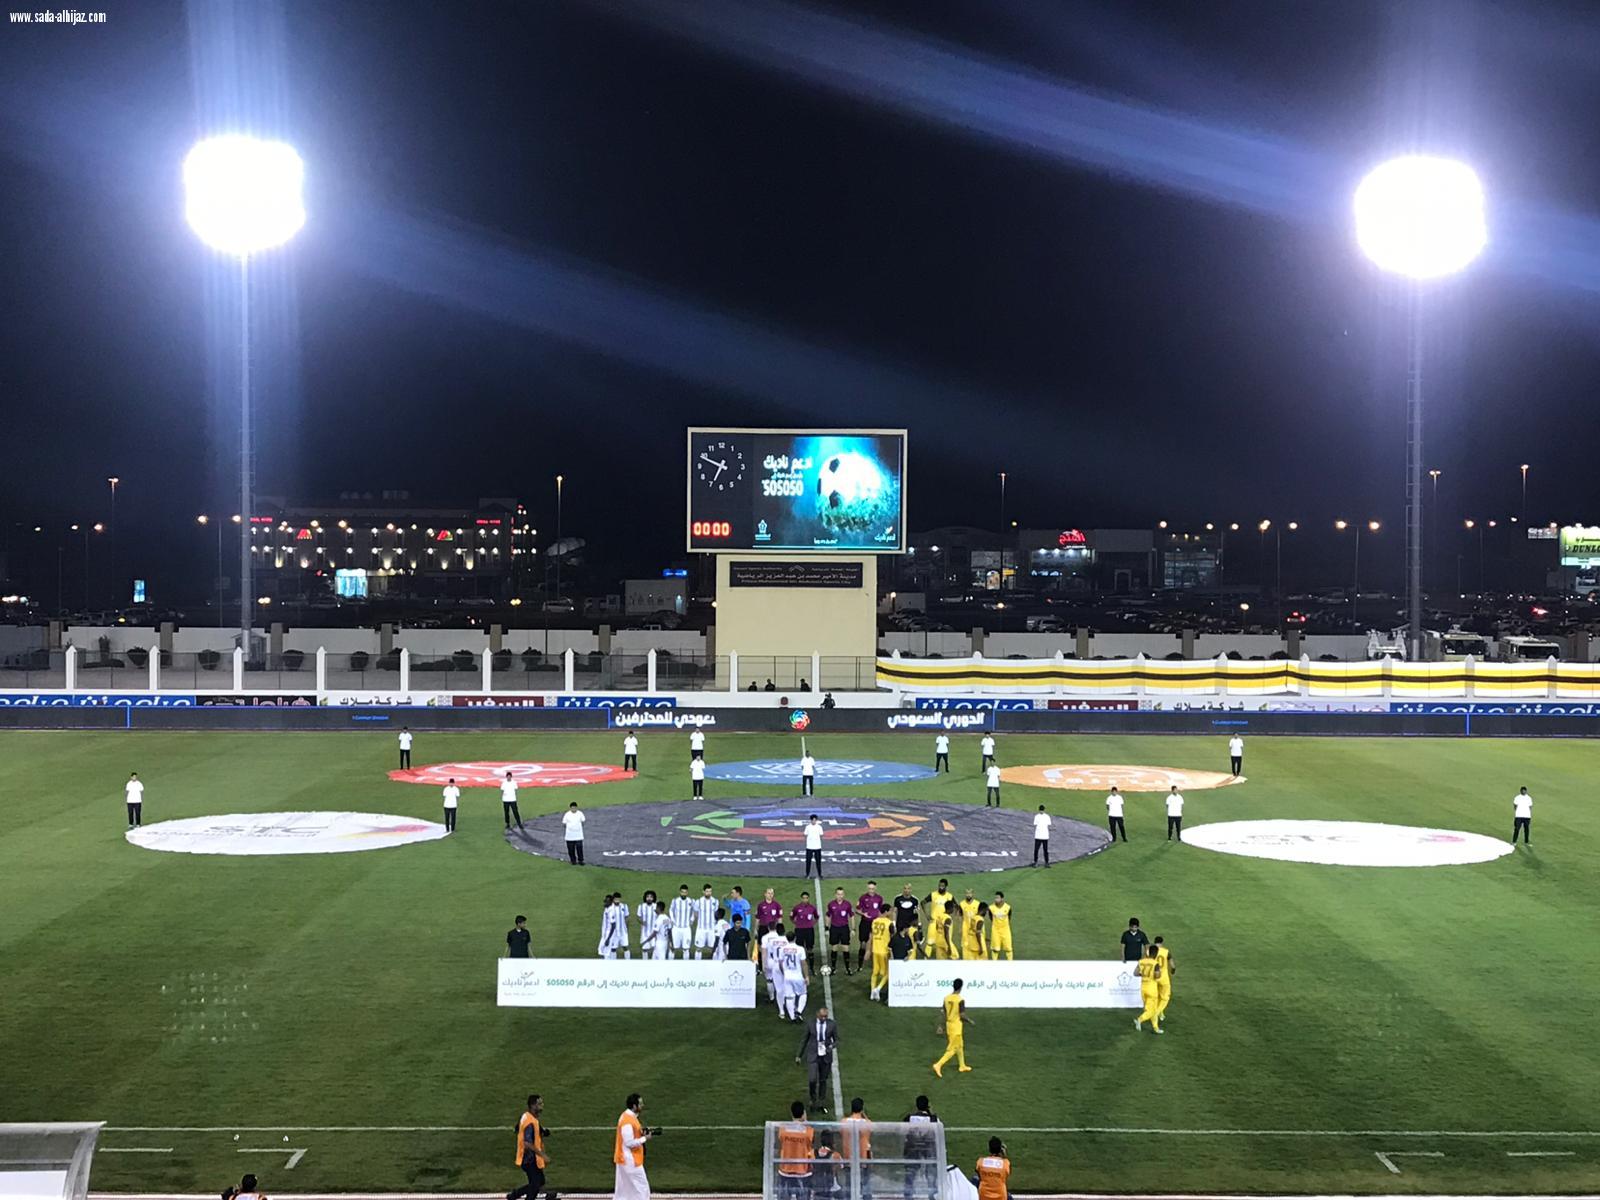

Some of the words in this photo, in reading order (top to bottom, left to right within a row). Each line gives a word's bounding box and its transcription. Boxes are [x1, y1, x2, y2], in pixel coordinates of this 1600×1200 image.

[763, 454, 789, 472] ناديك
[762, 479, 804, 496] 505050
[615, 711, 673, 727] للمحترفين
[887, 711, 942, 729] السعودي
[943, 712, 985, 729] الدوري
[603, 849, 752, 857] للمحترفين
[762, 849, 904, 857] السعودي
[913, 850, 1018, 858] الدوري
[873, 922, 885, 936] 39
[547, 979, 574, 987] 505050
[609, 980, 629, 989] ناديك
[676, 980, 696, 989] ناديك
[698, 979, 715, 989] ادعم
[998, 980, 1018, 990] ناديك
[1065, 980, 1085, 990] ناديك
[1087, 980, 1103, 990] ادعم
